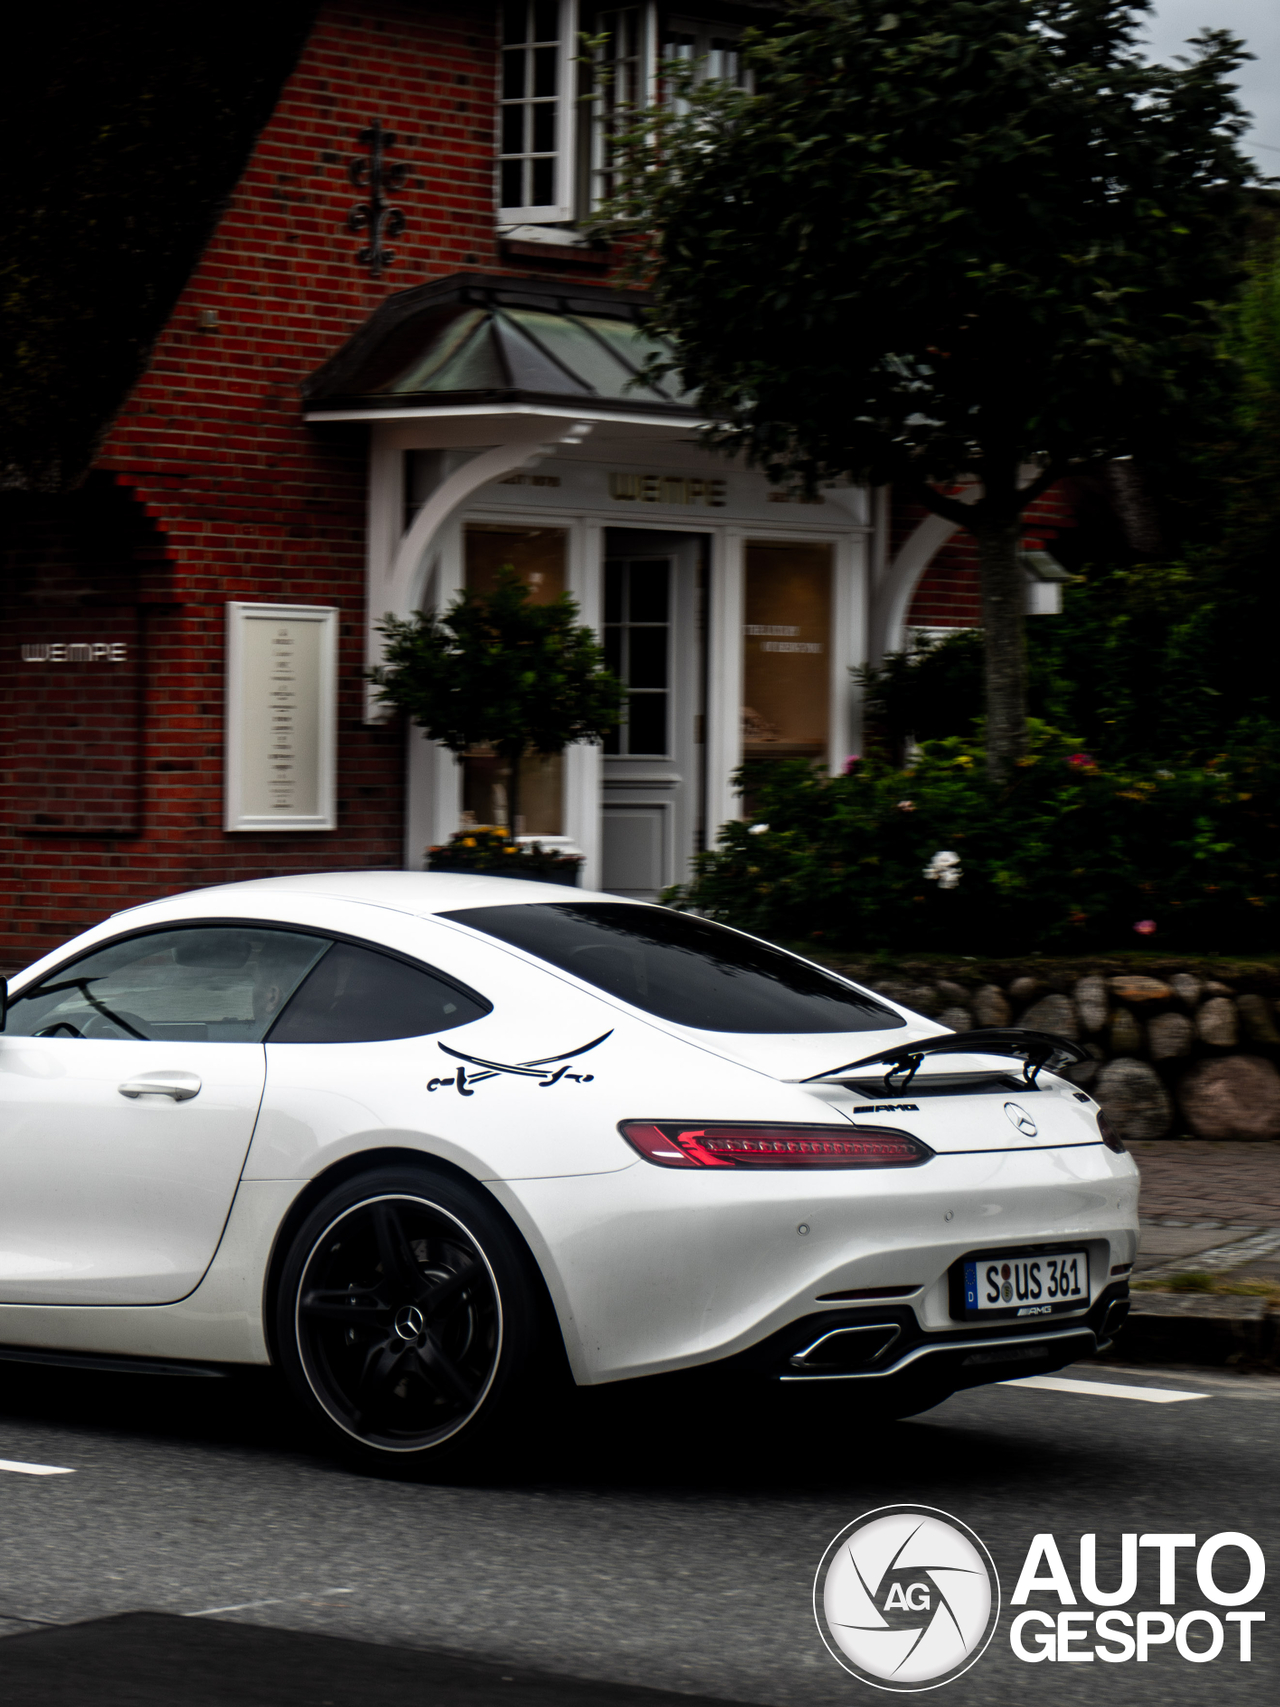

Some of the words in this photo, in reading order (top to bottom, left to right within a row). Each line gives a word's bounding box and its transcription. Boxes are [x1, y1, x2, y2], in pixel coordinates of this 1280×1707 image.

[608, 472, 727, 507] WEMPE
[21, 643, 128, 662] WEMPE
[874, 1104, 920, 1113] AMG
[986, 1265, 1001, 1303] S
[1014, 1262, 1042, 1301] US
[1047, 1258, 1081, 1298] 361
[967, 1291, 974, 1303] D
[1028, 1305, 1052, 1316] AMG
